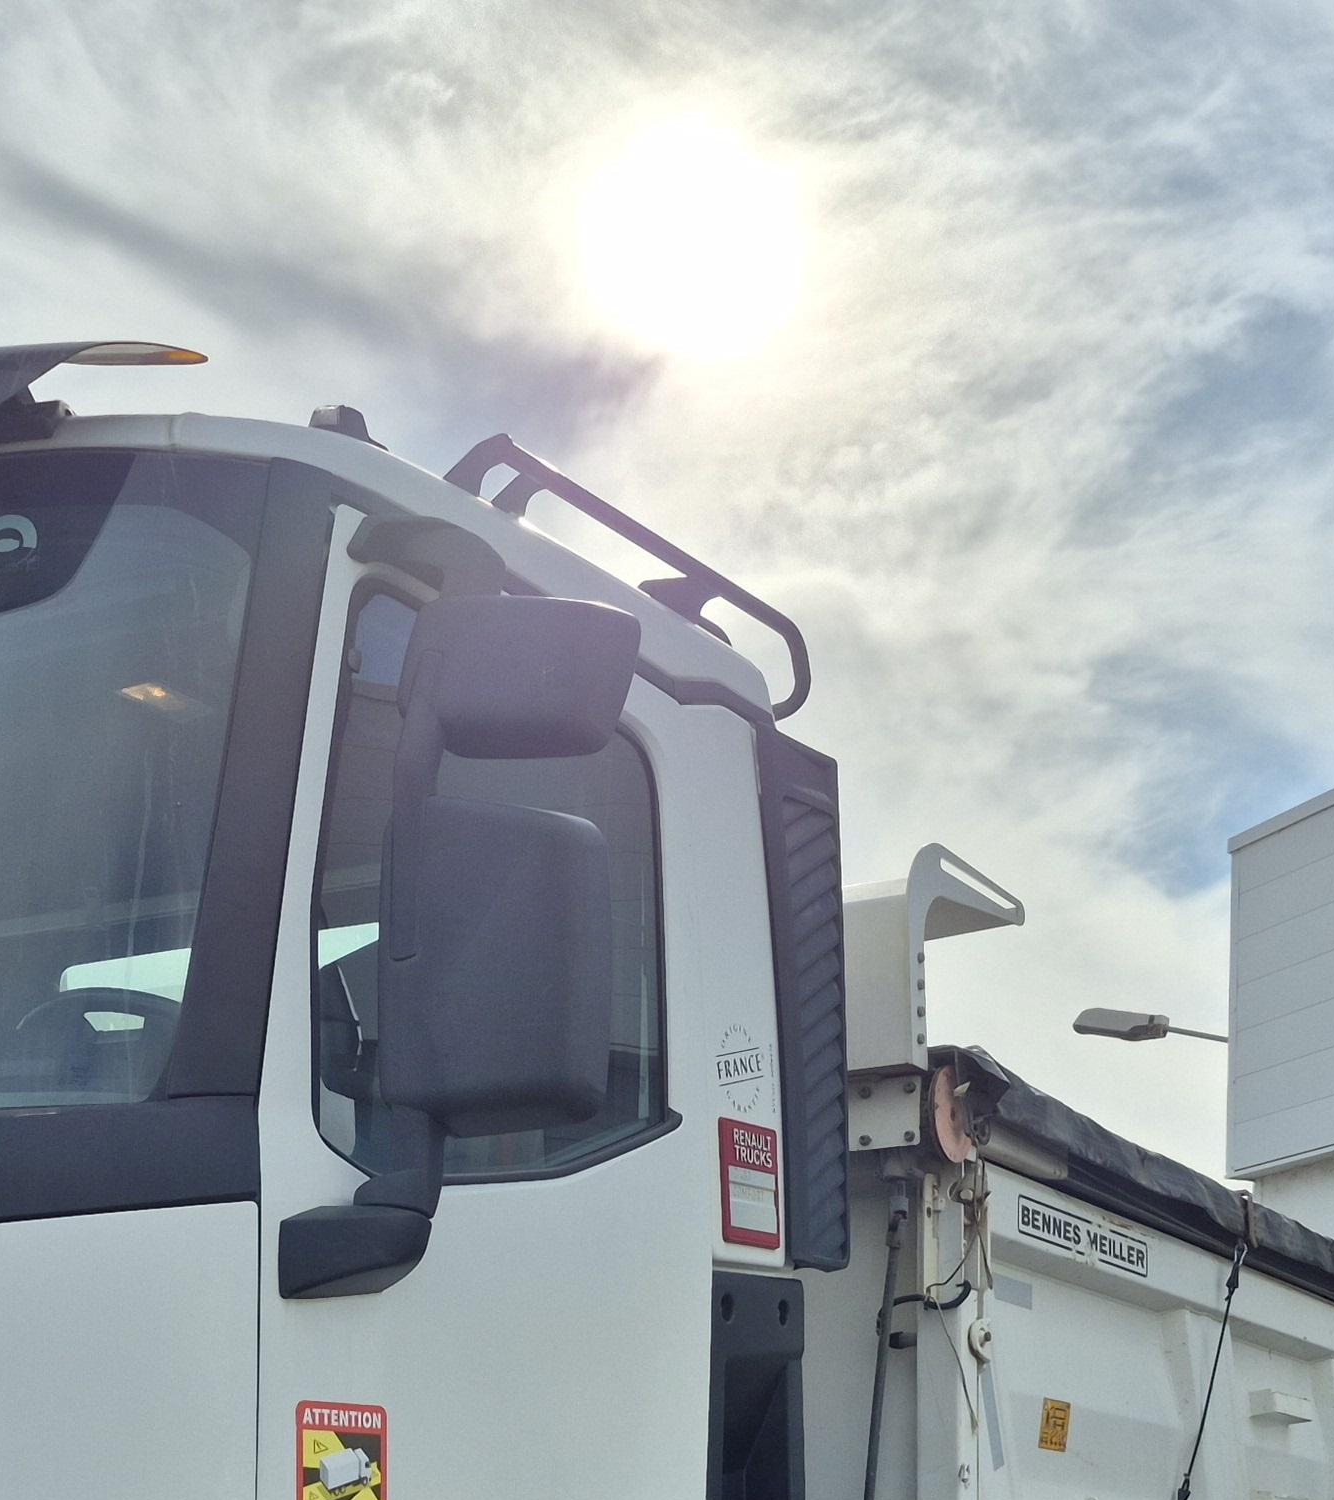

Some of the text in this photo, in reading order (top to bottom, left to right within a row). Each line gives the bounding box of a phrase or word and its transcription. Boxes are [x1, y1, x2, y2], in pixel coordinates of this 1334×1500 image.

[716, 1052, 762, 1080] FRANCE
[733, 1127, 772, 1151] RENAULT
[734, 1145, 773, 1169] TRUCKS
[1021, 1204, 1146, 1269] BENNES MEILLER
[302, 1407, 382, 1429] ATTENTION
